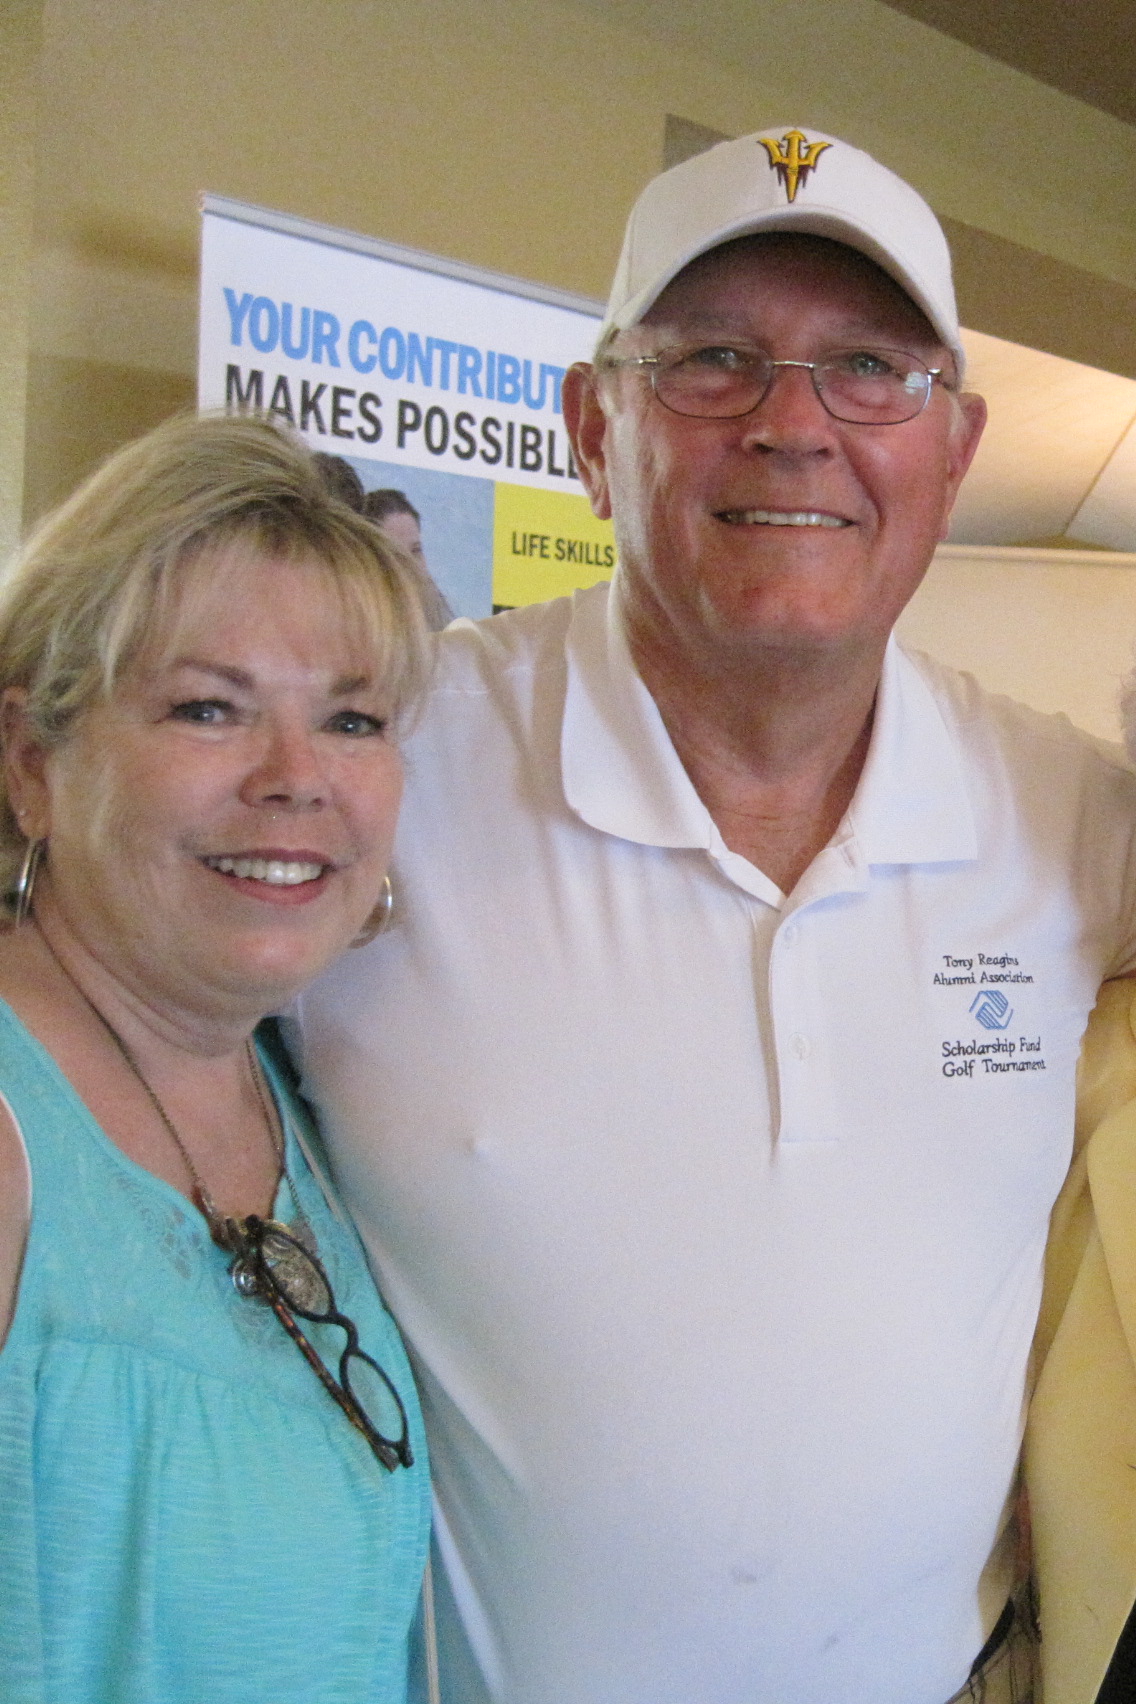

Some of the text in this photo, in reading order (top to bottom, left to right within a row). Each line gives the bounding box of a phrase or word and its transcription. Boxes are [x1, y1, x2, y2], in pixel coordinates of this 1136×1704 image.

[222, 287, 341, 368] YOUR
[225, 363, 383, 444] MAKES
[511, 531, 614, 568] LIFE SKILLS
[943, 953, 1019, 970] Tony Reagins
[933, 971, 1034, 985] Alumni Association
[942, 1037, 1041, 1057] Scholarship Fund
[942, 1058, 1047, 1078] Golf Tournament
